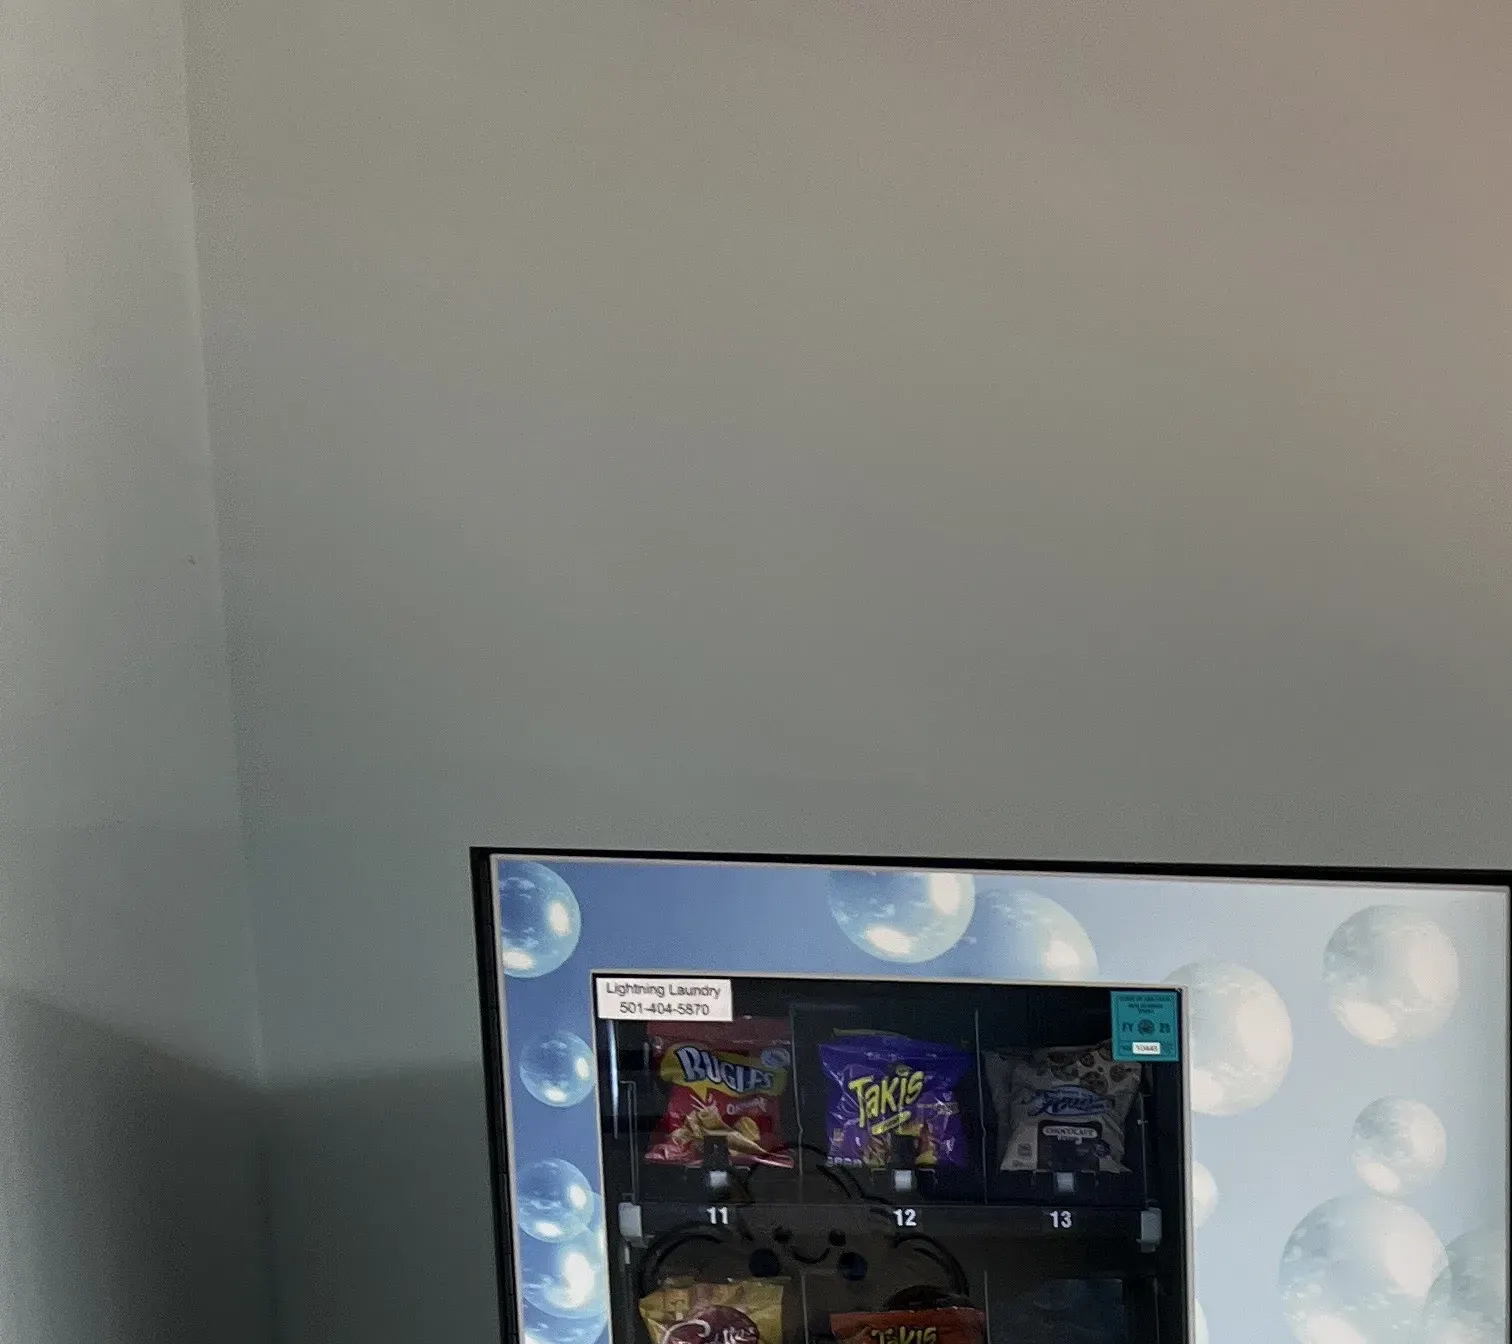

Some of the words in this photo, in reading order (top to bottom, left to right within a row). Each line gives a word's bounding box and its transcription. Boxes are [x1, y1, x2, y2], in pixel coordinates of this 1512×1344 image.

[606, 981, 665, 999] Lightning
[669, 981, 722, 1000] Laundry
[619, 1001, 710, 1016] 501-404-5870
[706, 1206, 729, 1225] 11
[894, 1208, 918, 1227] 12
[1050, 1210, 1073, 1229] 13
